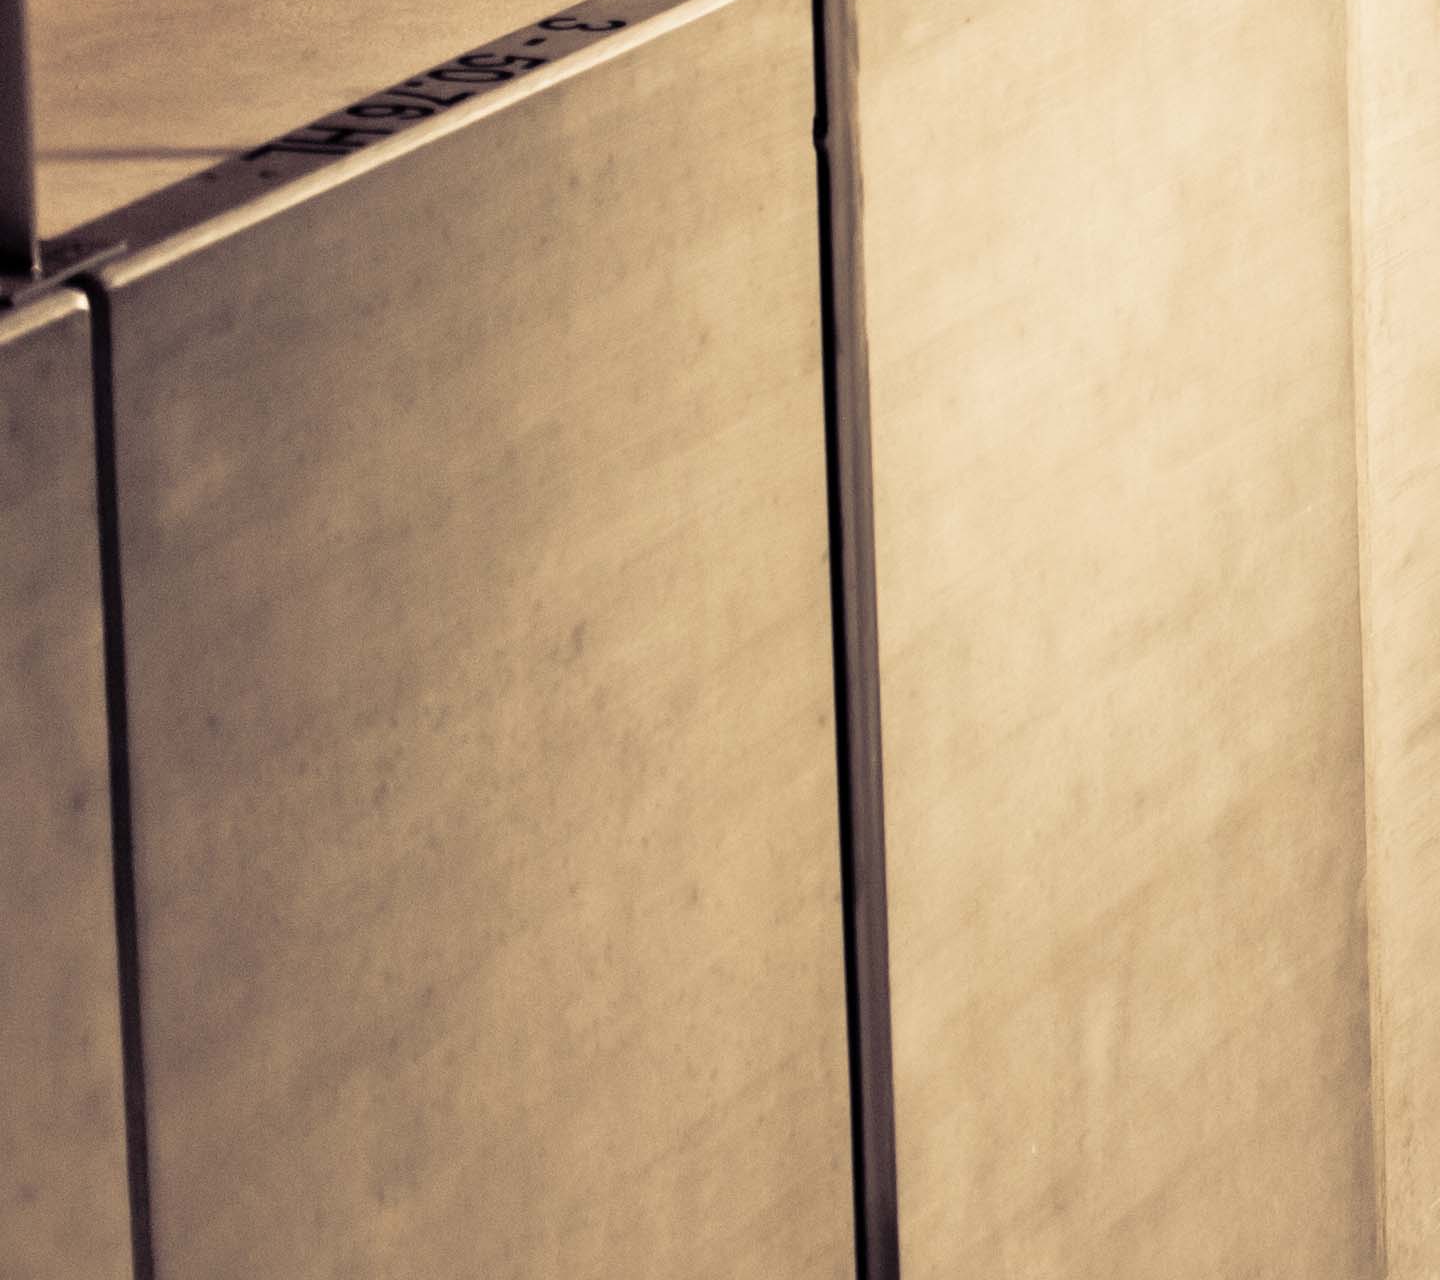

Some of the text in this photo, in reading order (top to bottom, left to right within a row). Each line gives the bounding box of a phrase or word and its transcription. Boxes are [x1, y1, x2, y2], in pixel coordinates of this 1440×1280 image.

[537, 16, 627, 33] 3
[345, 52, 549, 121] 50.76
[240, 123, 395, 162] HL
